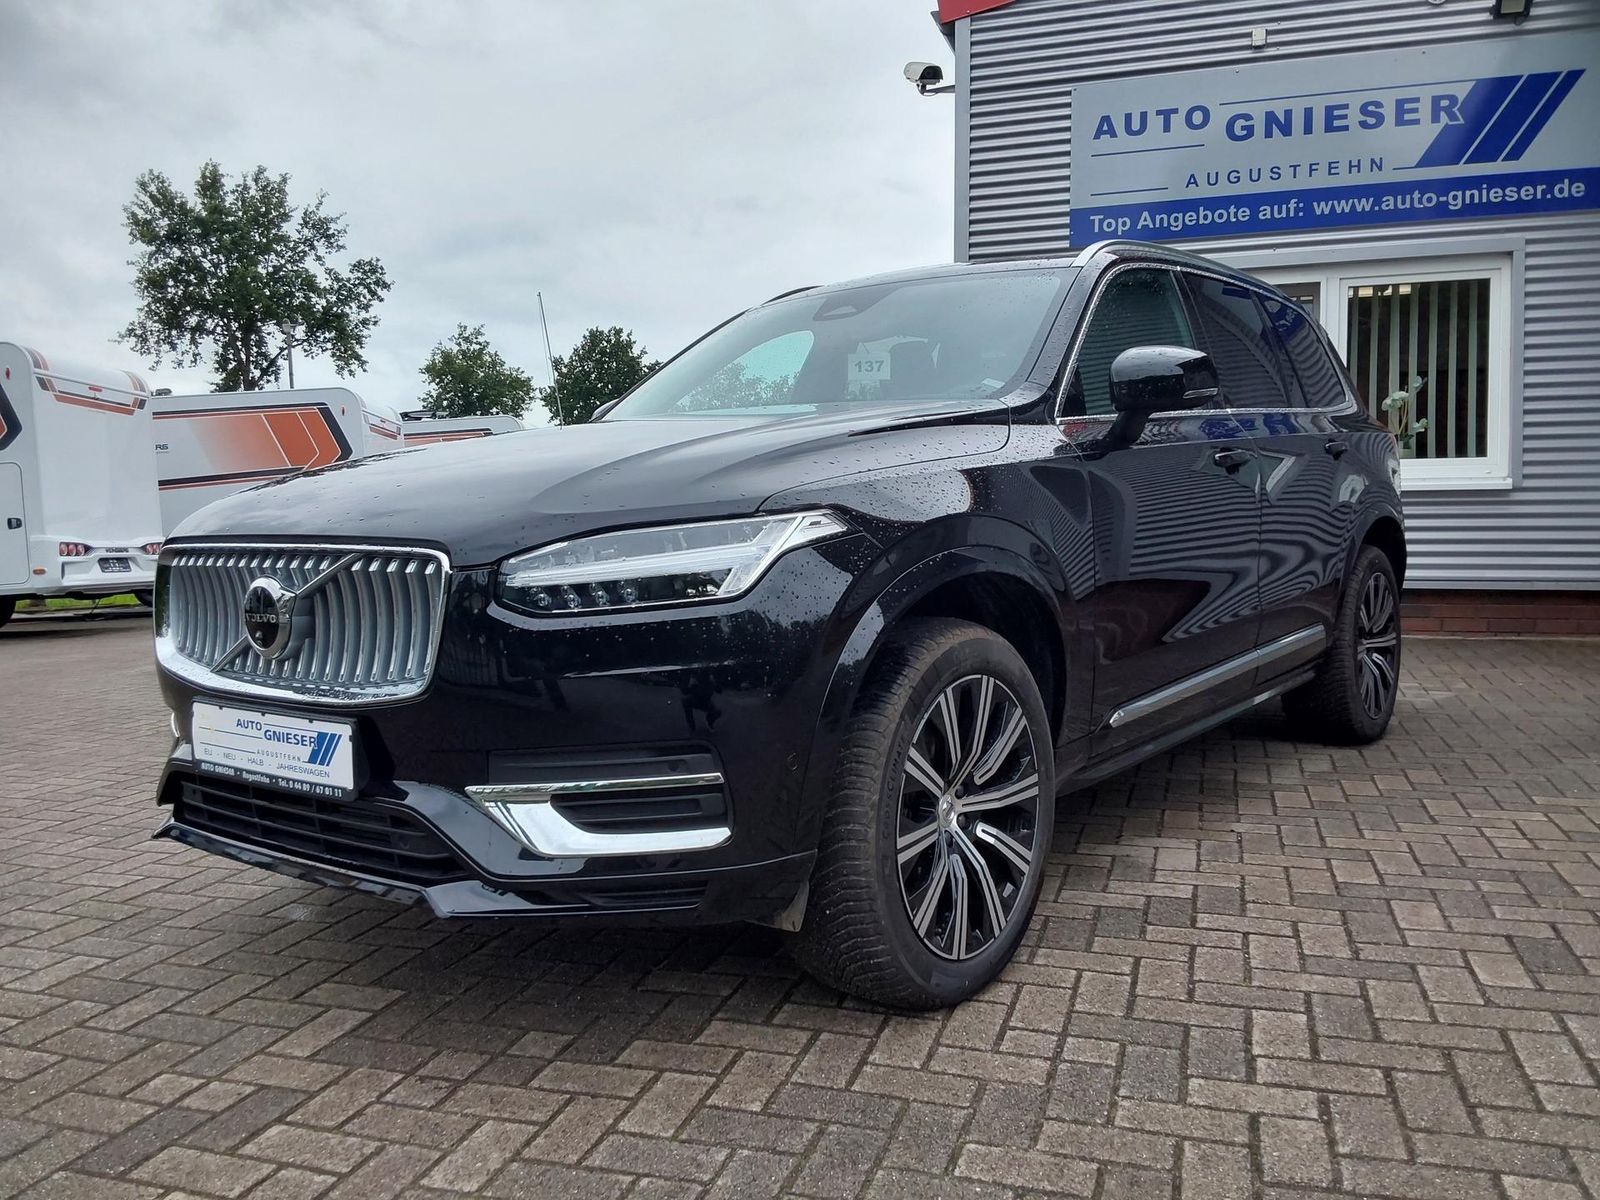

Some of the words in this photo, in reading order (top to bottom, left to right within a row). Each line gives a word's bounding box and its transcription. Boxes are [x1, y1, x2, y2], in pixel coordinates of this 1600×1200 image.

[1092, 105, 1211, 141] AUTO
[1225, 93, 1464, 142] GNIESER
[1185, 156, 1384, 189] AUGUSTFEHN
[1090, 215, 1131, 236] Top
[1137, 205, 1250, 232] Angebote
[1258, 198, 1304, 220] auf:
[1313, 178, 1586, 216] www.auto-gnieser.de
[854, 360, 885, 373] 137
[246, 612, 278, 624] VOLVO
[236, 718, 263, 731] AUTO
[264, 729, 318, 749] GNIESER
[247, 756, 265, 767] HALB
[277, 763, 330, 778] JAHRESWAGEN
